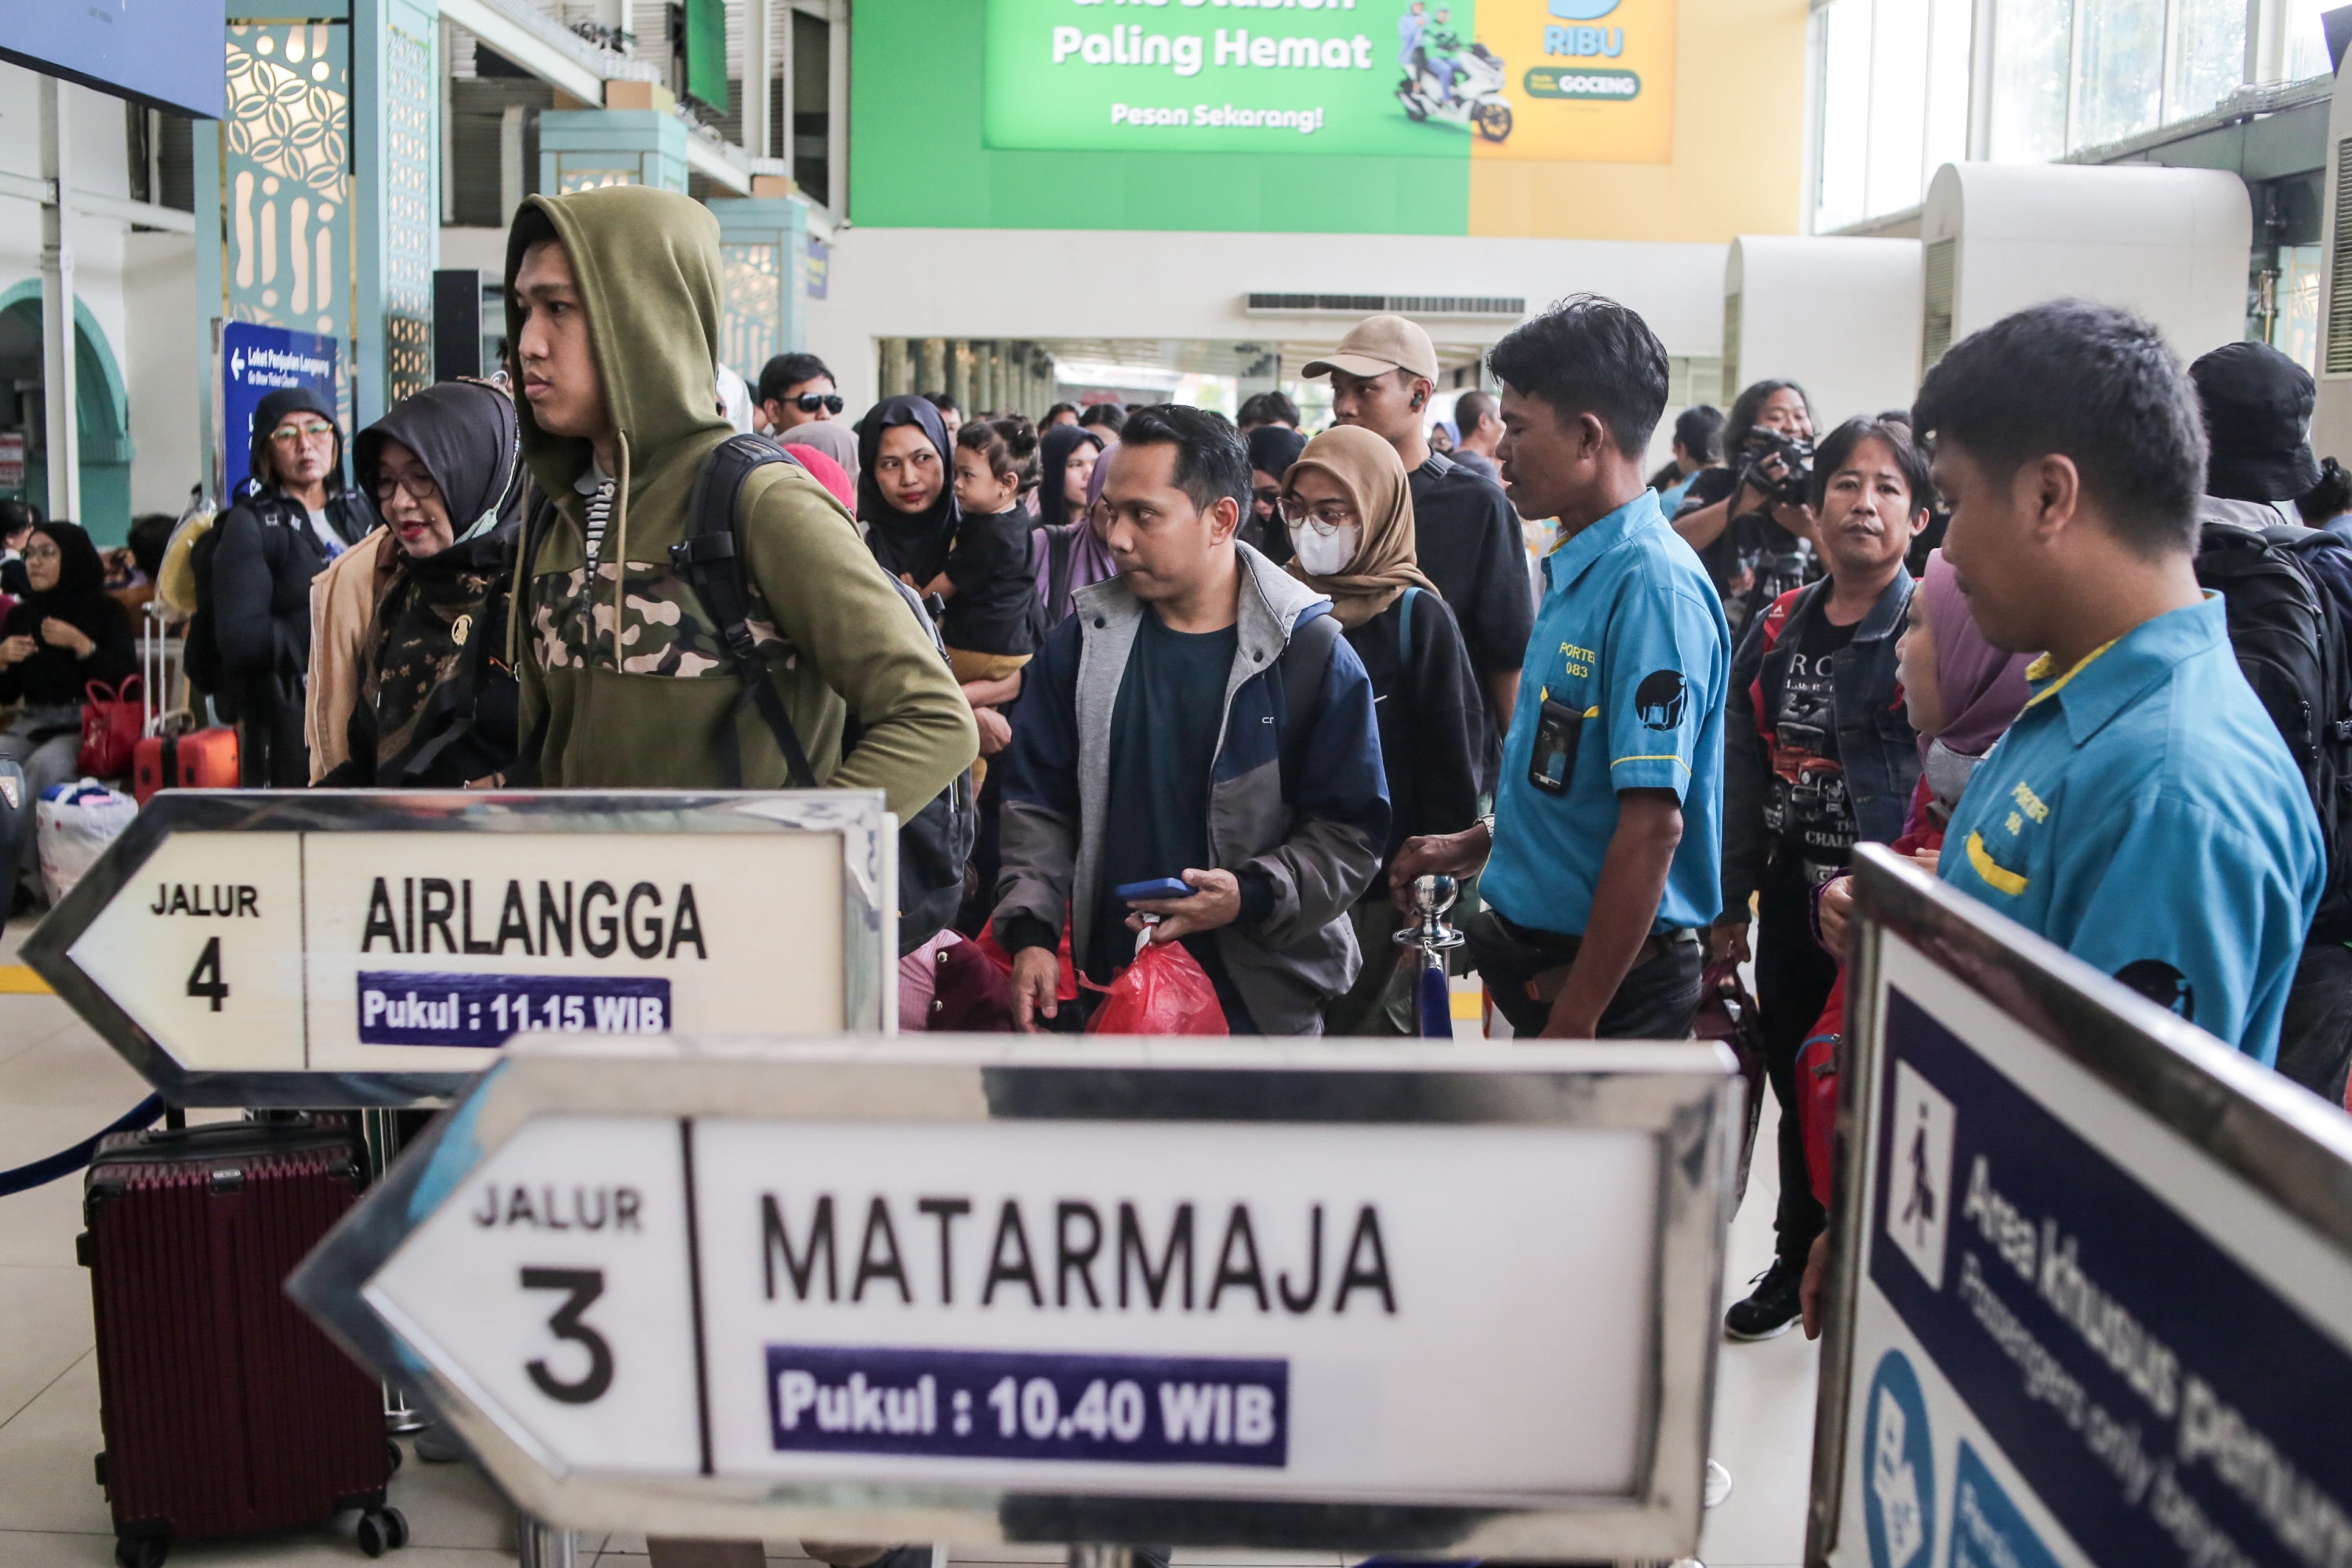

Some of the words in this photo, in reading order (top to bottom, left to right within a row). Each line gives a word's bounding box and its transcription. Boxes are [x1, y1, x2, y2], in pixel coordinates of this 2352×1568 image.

[1052, 24, 1203, 76] Paling
[1214, 28, 1374, 70] Hemat
[1544, 25, 1624, 57] RIBU
[1559, 75, 1635, 95] GOCENG
[1111, 103, 1189, 126] Pesan
[1192, 104, 1325, 134] Sekarang!
[1559, 641, 1595, 665] PORTE
[1566, 662, 1588, 678] 083
[151, 884, 260, 917] JALUR
[361, 877, 708, 960] AIRLANGGA
[186, 936, 229, 1012] 4
[363, 990, 460, 1029] Pukul
[490, 994, 586, 1033] 11.15
[593, 996, 665, 1036] WIB
[474, 1183, 644, 1232] JALUR
[1962, 1152, 2038, 1283] Area
[760, 1192, 1399, 1316] MATARMAJA
[519, 1265, 614, 1405] 3
[777, 1370, 937, 1436] Pukul
[988, 1377, 1145, 1443] 10.40
[1160, 1383, 1277, 1446] WIB
